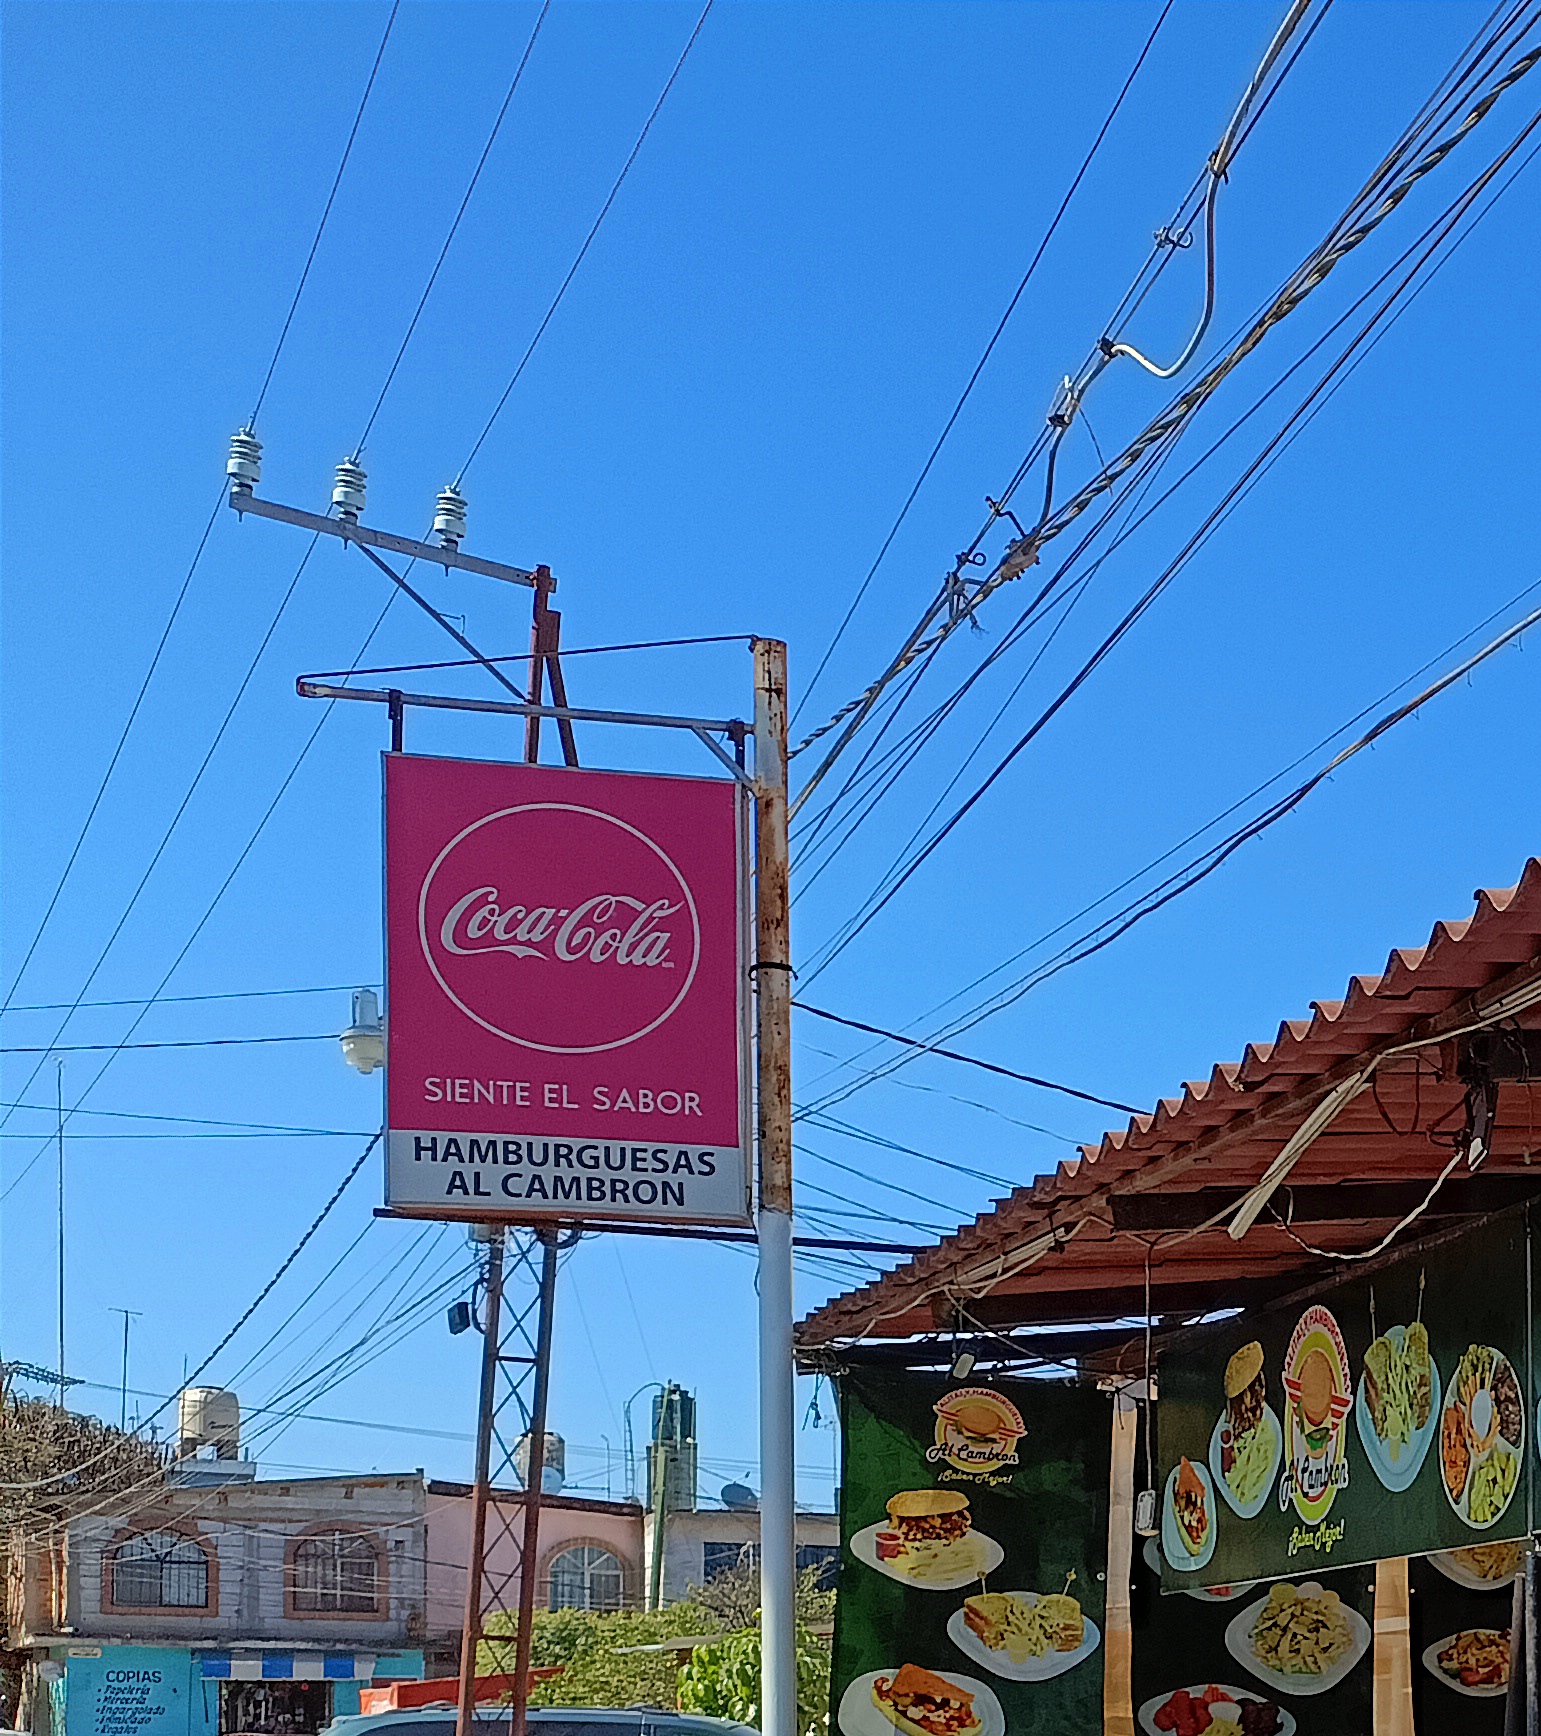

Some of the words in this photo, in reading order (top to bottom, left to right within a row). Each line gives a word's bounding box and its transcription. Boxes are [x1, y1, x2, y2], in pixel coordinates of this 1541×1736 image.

[441, 886, 685, 967] Coca-Cola
[424, 1078, 531, 1106] SIENTE
[544, 1084, 579, 1110] EL
[593, 1087, 703, 1116] SABOR
[414, 1136, 716, 1177] HAMBURGUESAS
[445, 1171, 492, 1197] AL
[501, 1173, 685, 1207] CAMBRON
[929, 1442, 954, 1459] Al
[958, 1444, 1016, 1462] Cambron
[106, 1670, 162, 1683] COPIAS
